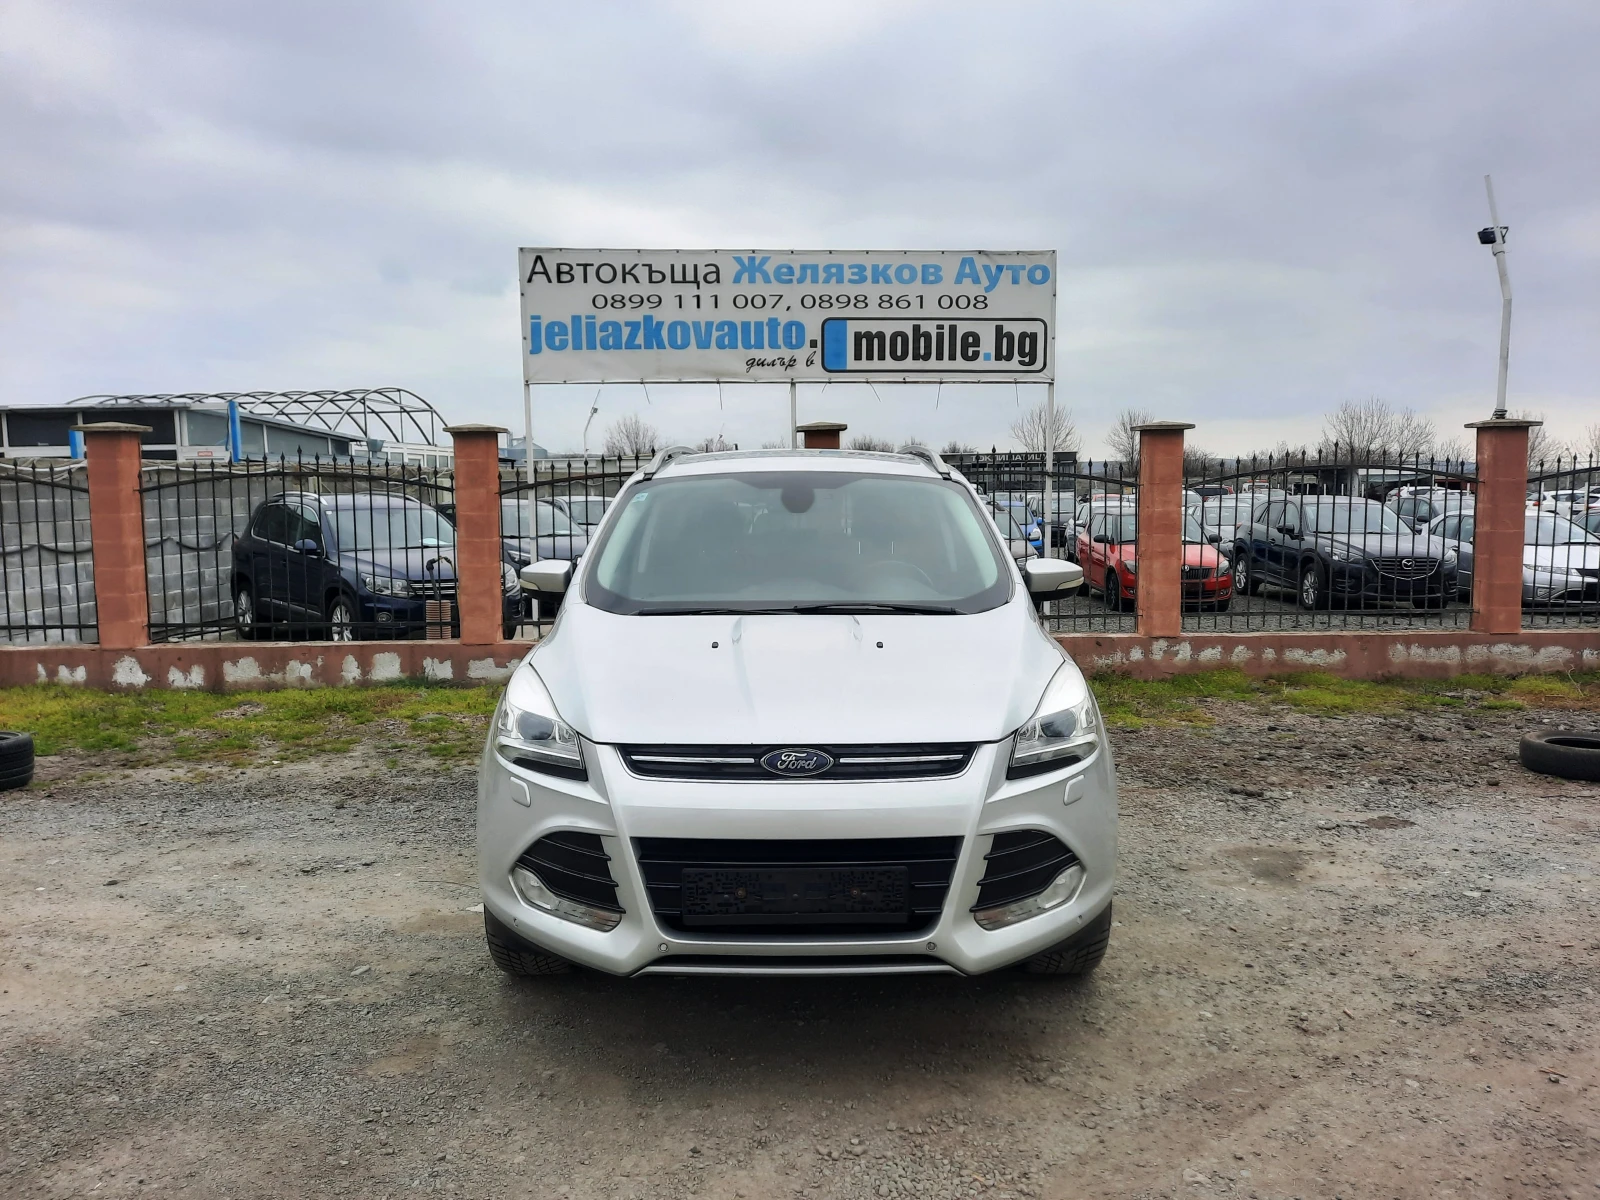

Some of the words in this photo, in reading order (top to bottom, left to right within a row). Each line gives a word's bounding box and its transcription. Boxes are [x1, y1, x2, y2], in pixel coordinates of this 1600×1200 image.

[526, 255, 721, 290] Автокъща
[732, 255, 944, 285] Желязков
[953, 256, 1051, 293] Ауто
[591, 293, 663, 310] 0899
[674, 293, 719, 310] 111
[732, 293, 792, 312] 007,
[800, 293, 869, 310] 0898
[877, 293, 925, 310] 861
[937, 294, 989, 310] 008
[853, 324, 1038, 367] mobile.bg
[745, 354, 798, 374] дилър
[777, 752, 818, 769] Ford
